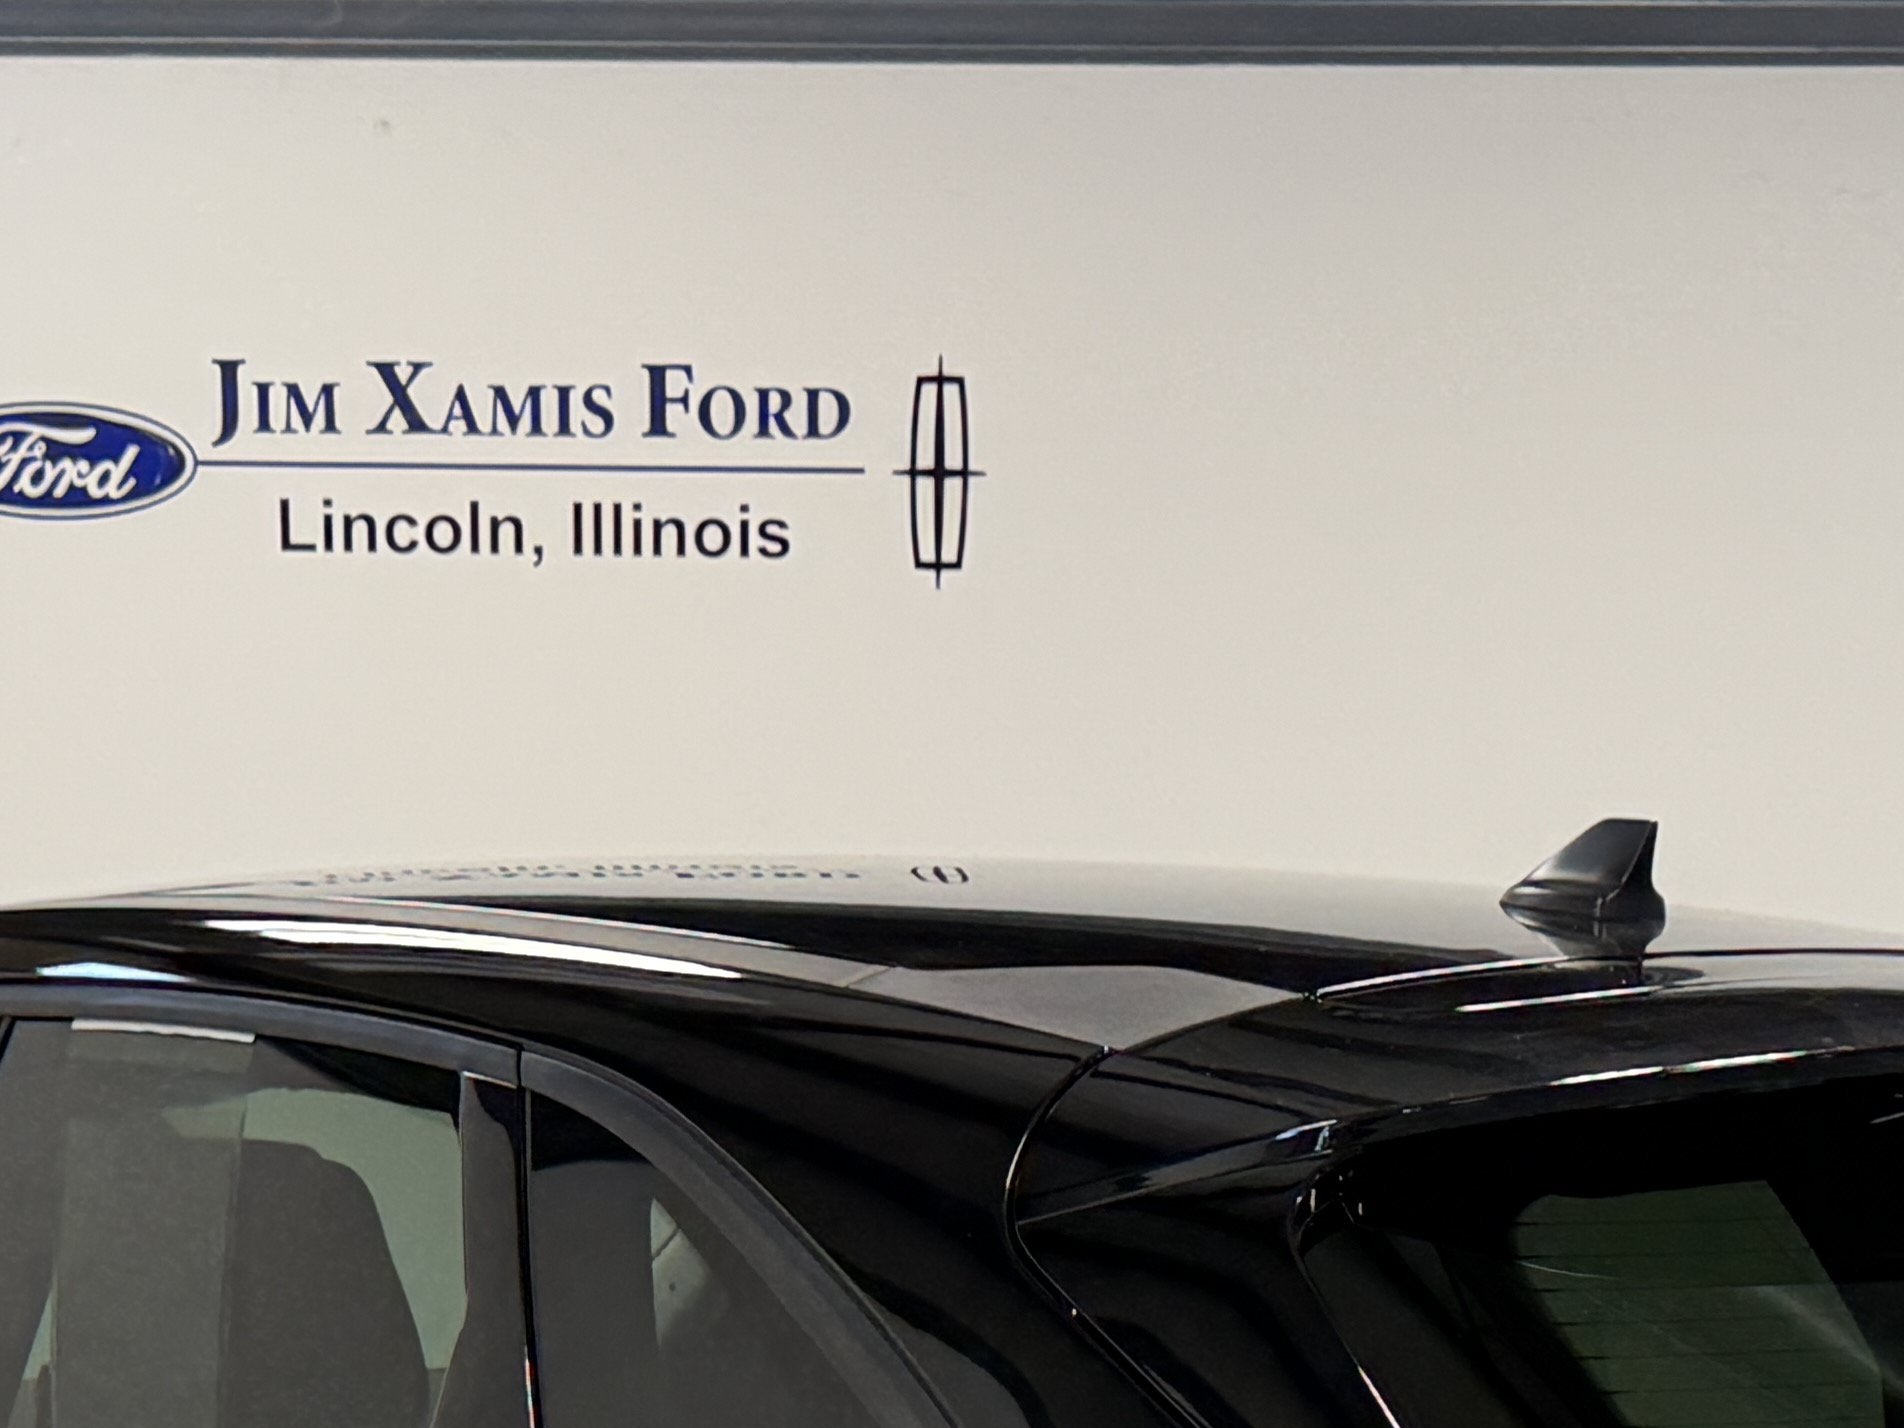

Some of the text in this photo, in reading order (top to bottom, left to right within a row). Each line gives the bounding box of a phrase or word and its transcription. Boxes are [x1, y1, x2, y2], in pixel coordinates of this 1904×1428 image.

[211, 358, 852, 447] JIM XAMIS FORD
[279, 498, 791, 567] Lincoln, Illinois
